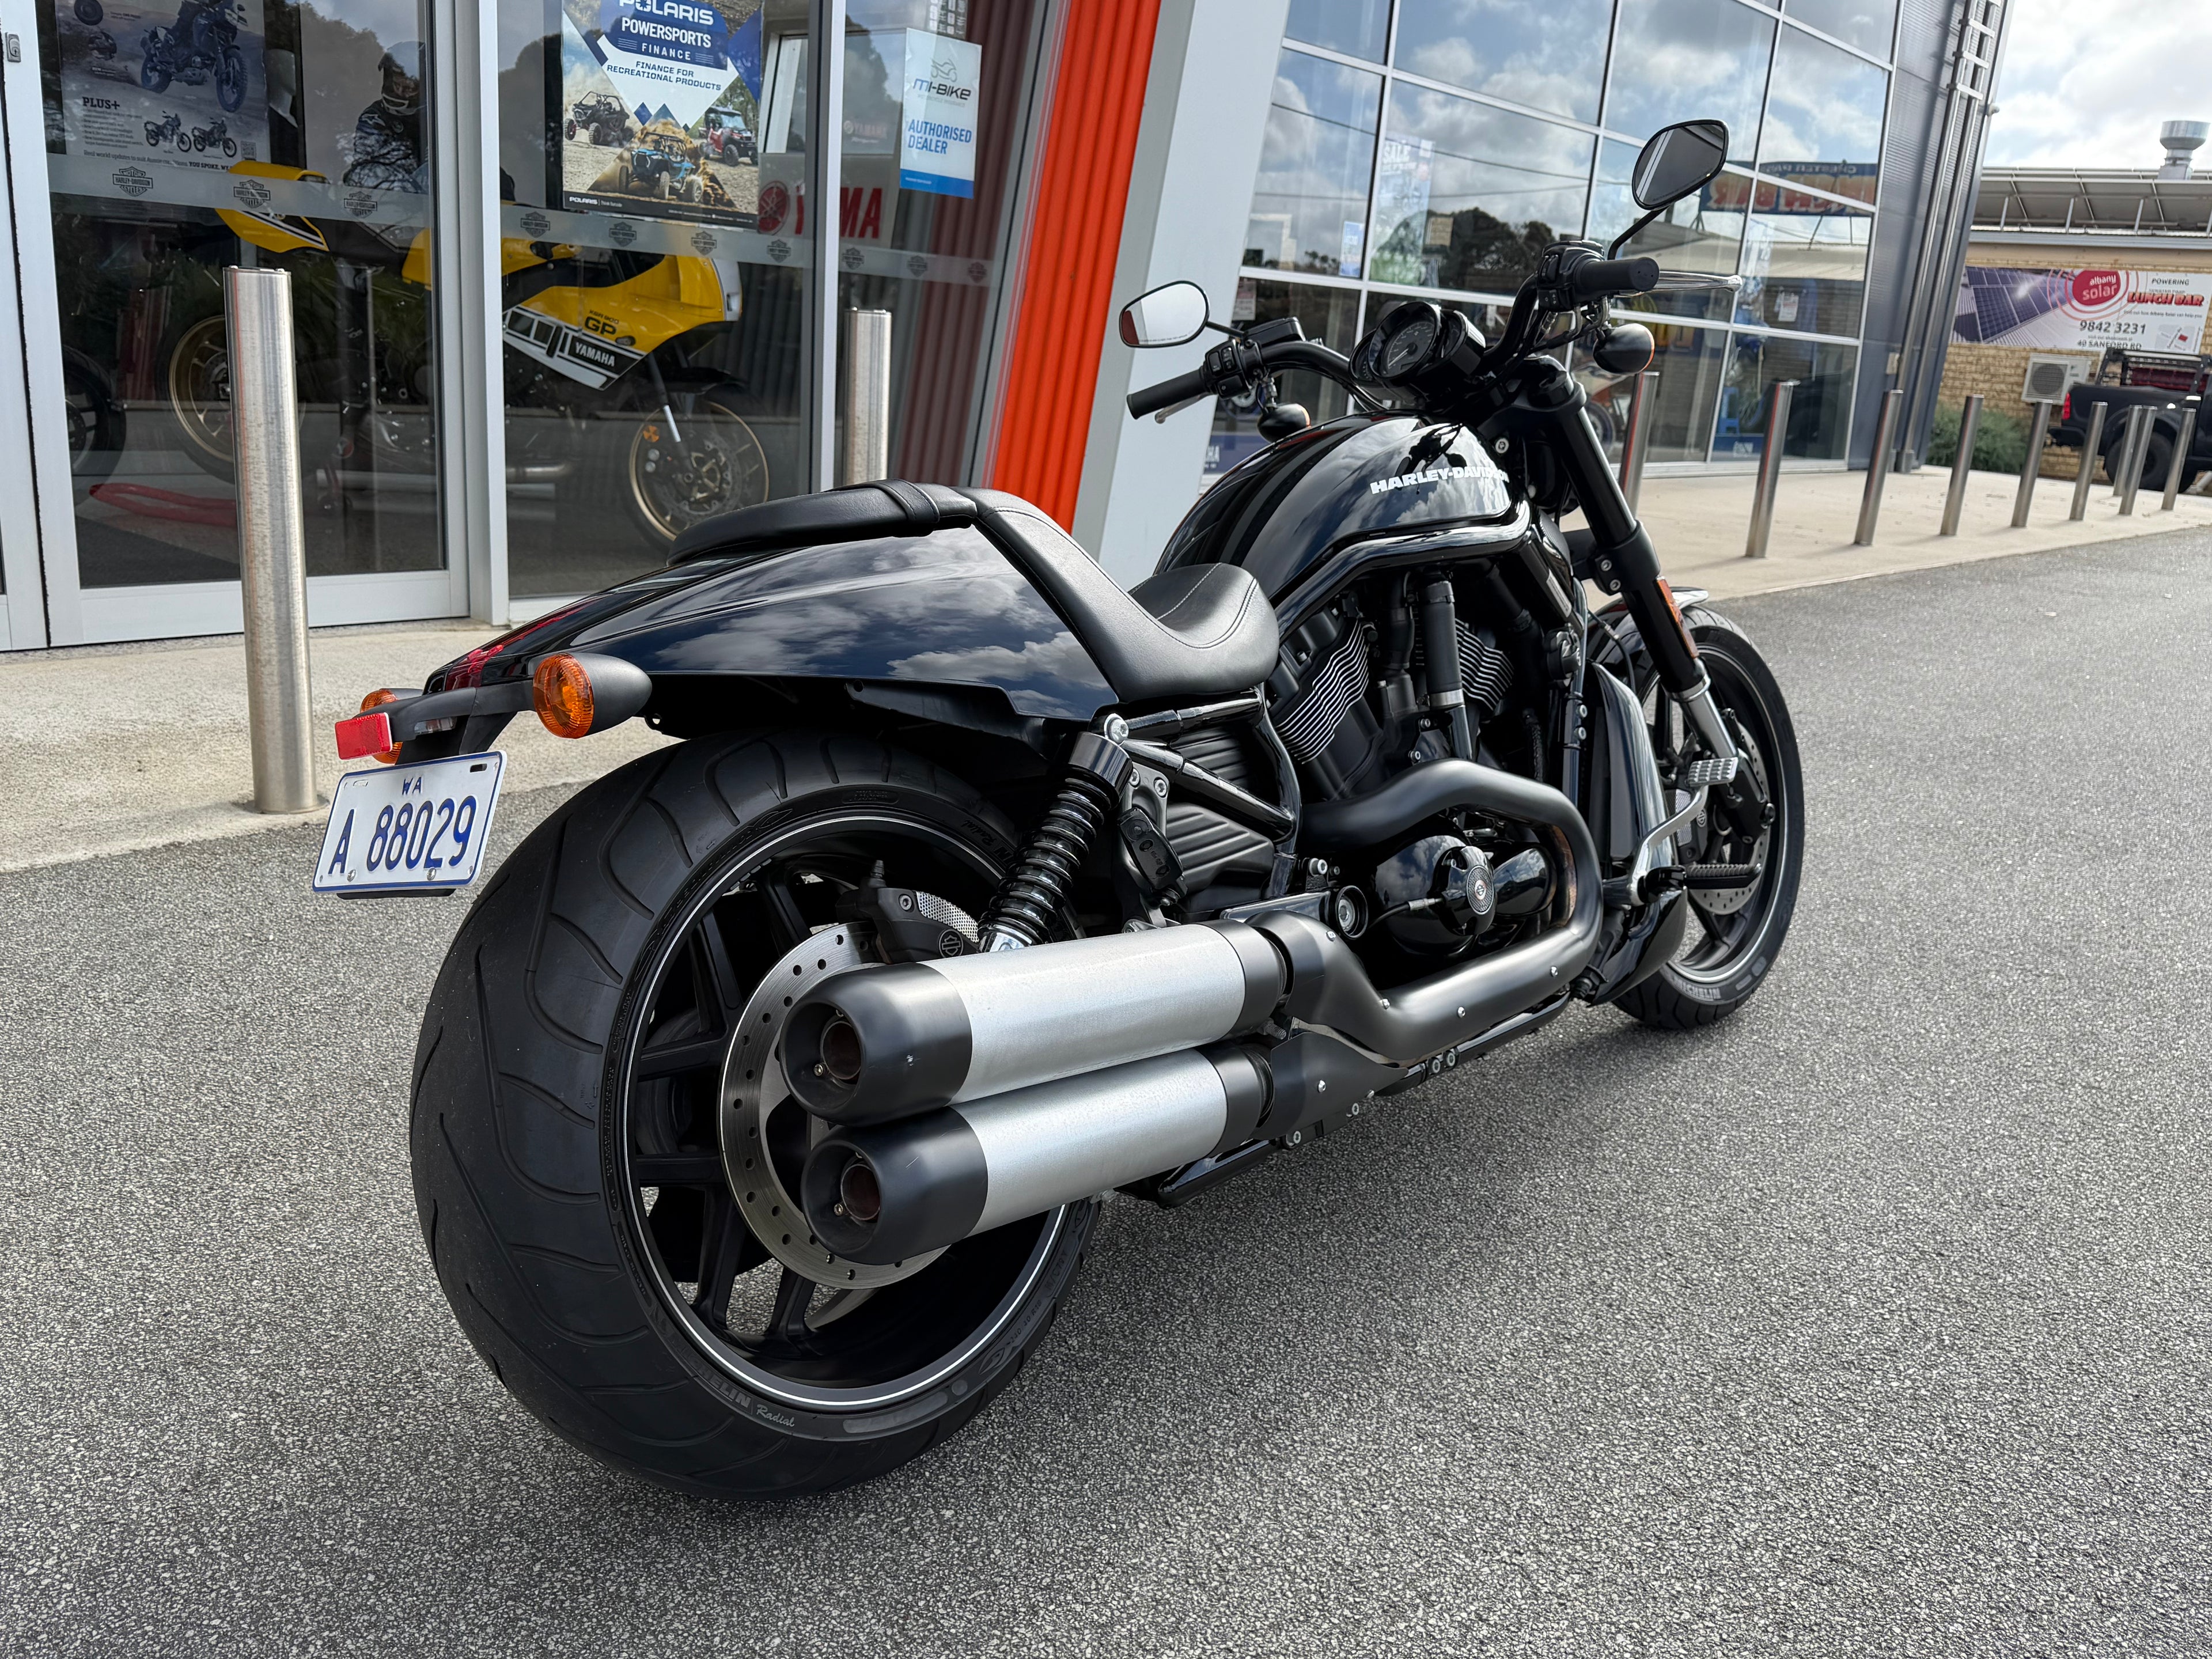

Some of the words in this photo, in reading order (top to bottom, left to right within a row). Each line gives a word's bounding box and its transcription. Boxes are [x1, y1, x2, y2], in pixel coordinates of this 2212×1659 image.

[622, 17, 711, 48] POWERSPORTS
[642, 42, 691, 60] FINANCE
[607, 65, 673, 83] RECREATIONAL
[675, 77, 721, 91] PRODUCTS
[636, 60, 675, 74] FINANCE
[677, 69, 694, 78] FOR
[908, 119, 972, 143] AUTHORISED
[908, 135, 948, 154] DEALER
[115, 177, 151, 186] HARLEY-DAVIDSON
[2089, 274, 2116, 286] albany
[2152, 277, 2190, 286] POWERING
[2082, 284, 2118, 301] solar
[2127, 291, 2174, 305] LUNCH
[2175, 294, 2205, 306] BAR
[585, 316, 617, 336] GP
[2080, 320, 2111, 334] 9842
[2114, 321, 2146, 335] 3231
[575, 341, 615, 367] YAMAHA
[402, 777, 422, 795] WA
[328, 808, 354, 874] A
[366, 795, 477, 872] 88029
[756, 1403, 795, 1428] Radial
